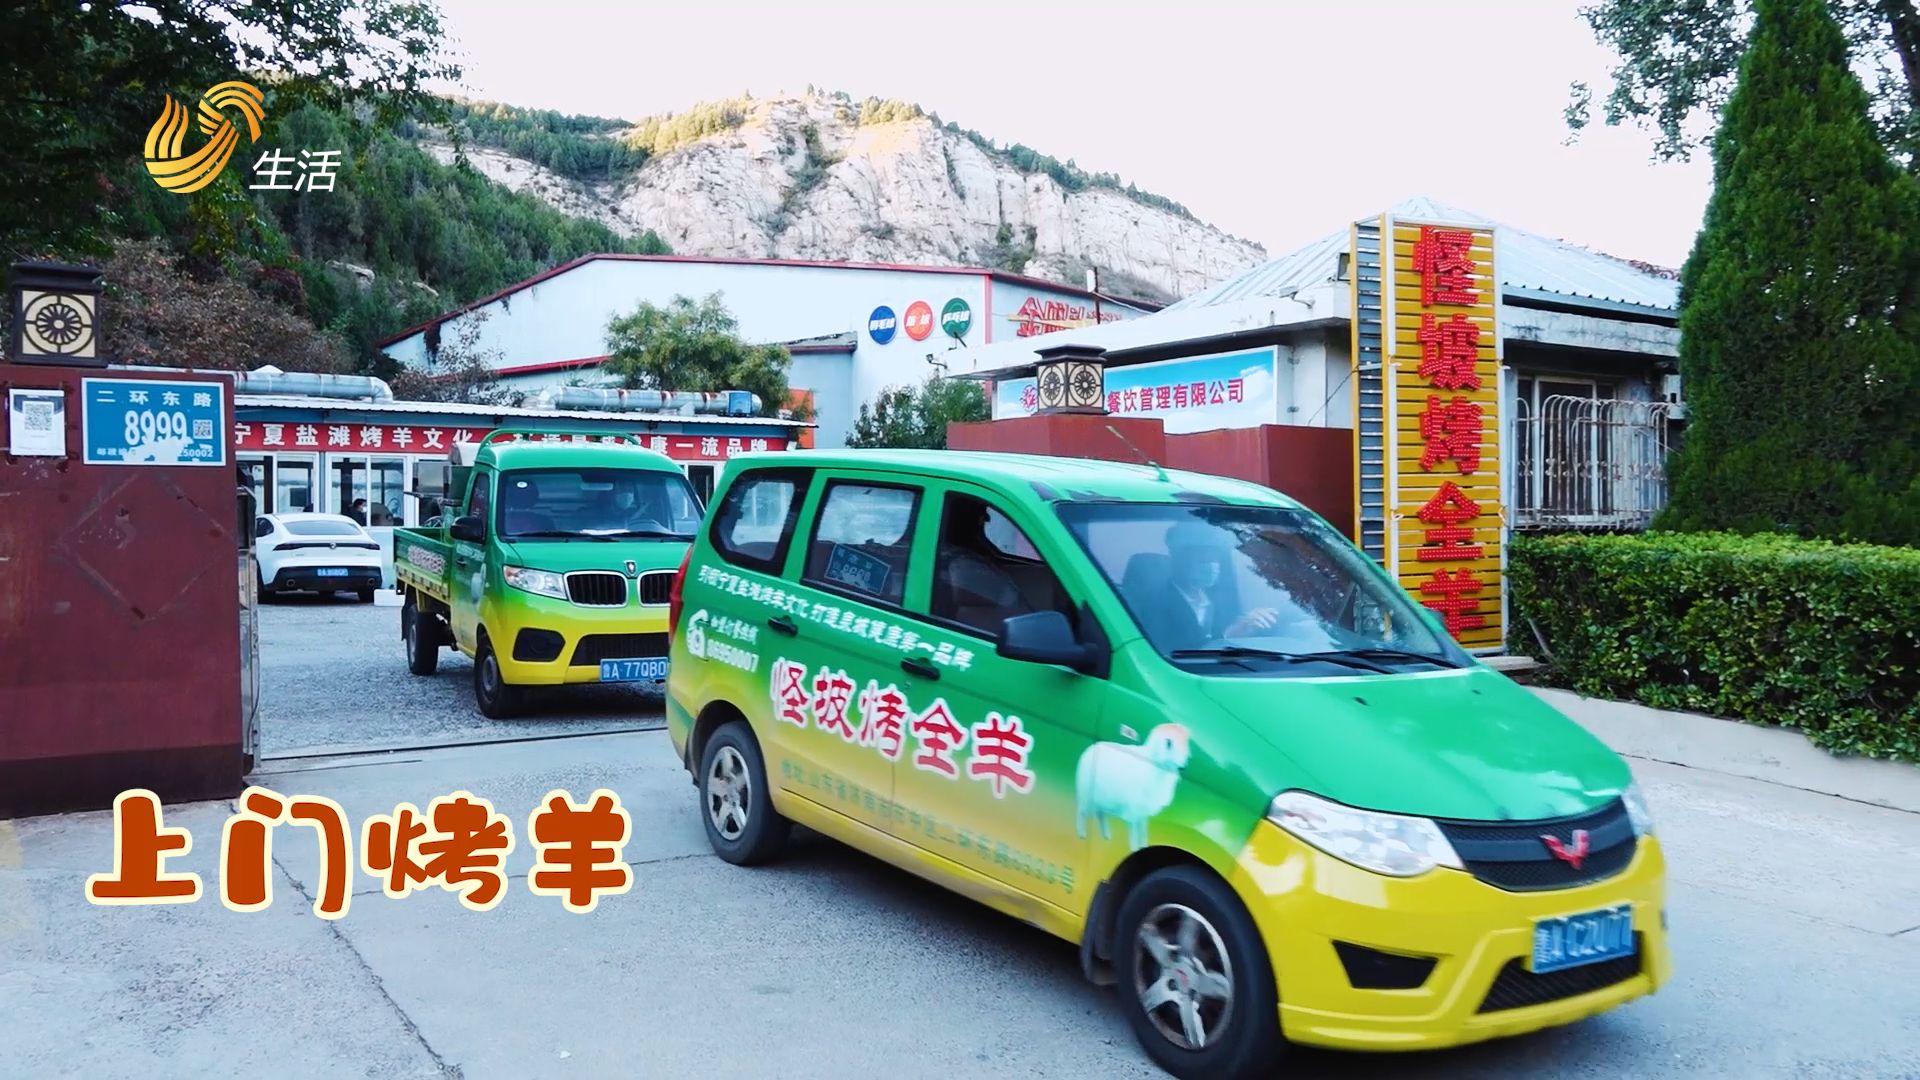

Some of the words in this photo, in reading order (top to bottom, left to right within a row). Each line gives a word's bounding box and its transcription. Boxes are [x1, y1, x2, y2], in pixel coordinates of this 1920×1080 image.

[96, 390, 212, 408] 二环东路
[1107, 377, 1245, 415] 餐饮管理有限公司
[124, 409, 188, 446] 8999
[234, 422, 473, 449] 宁夏盐滩烤羊文化
[1412, 224, 1487, 642] 怪坡烤全羊
[770, 657, 1034, 799] 怪坡烤全羊
